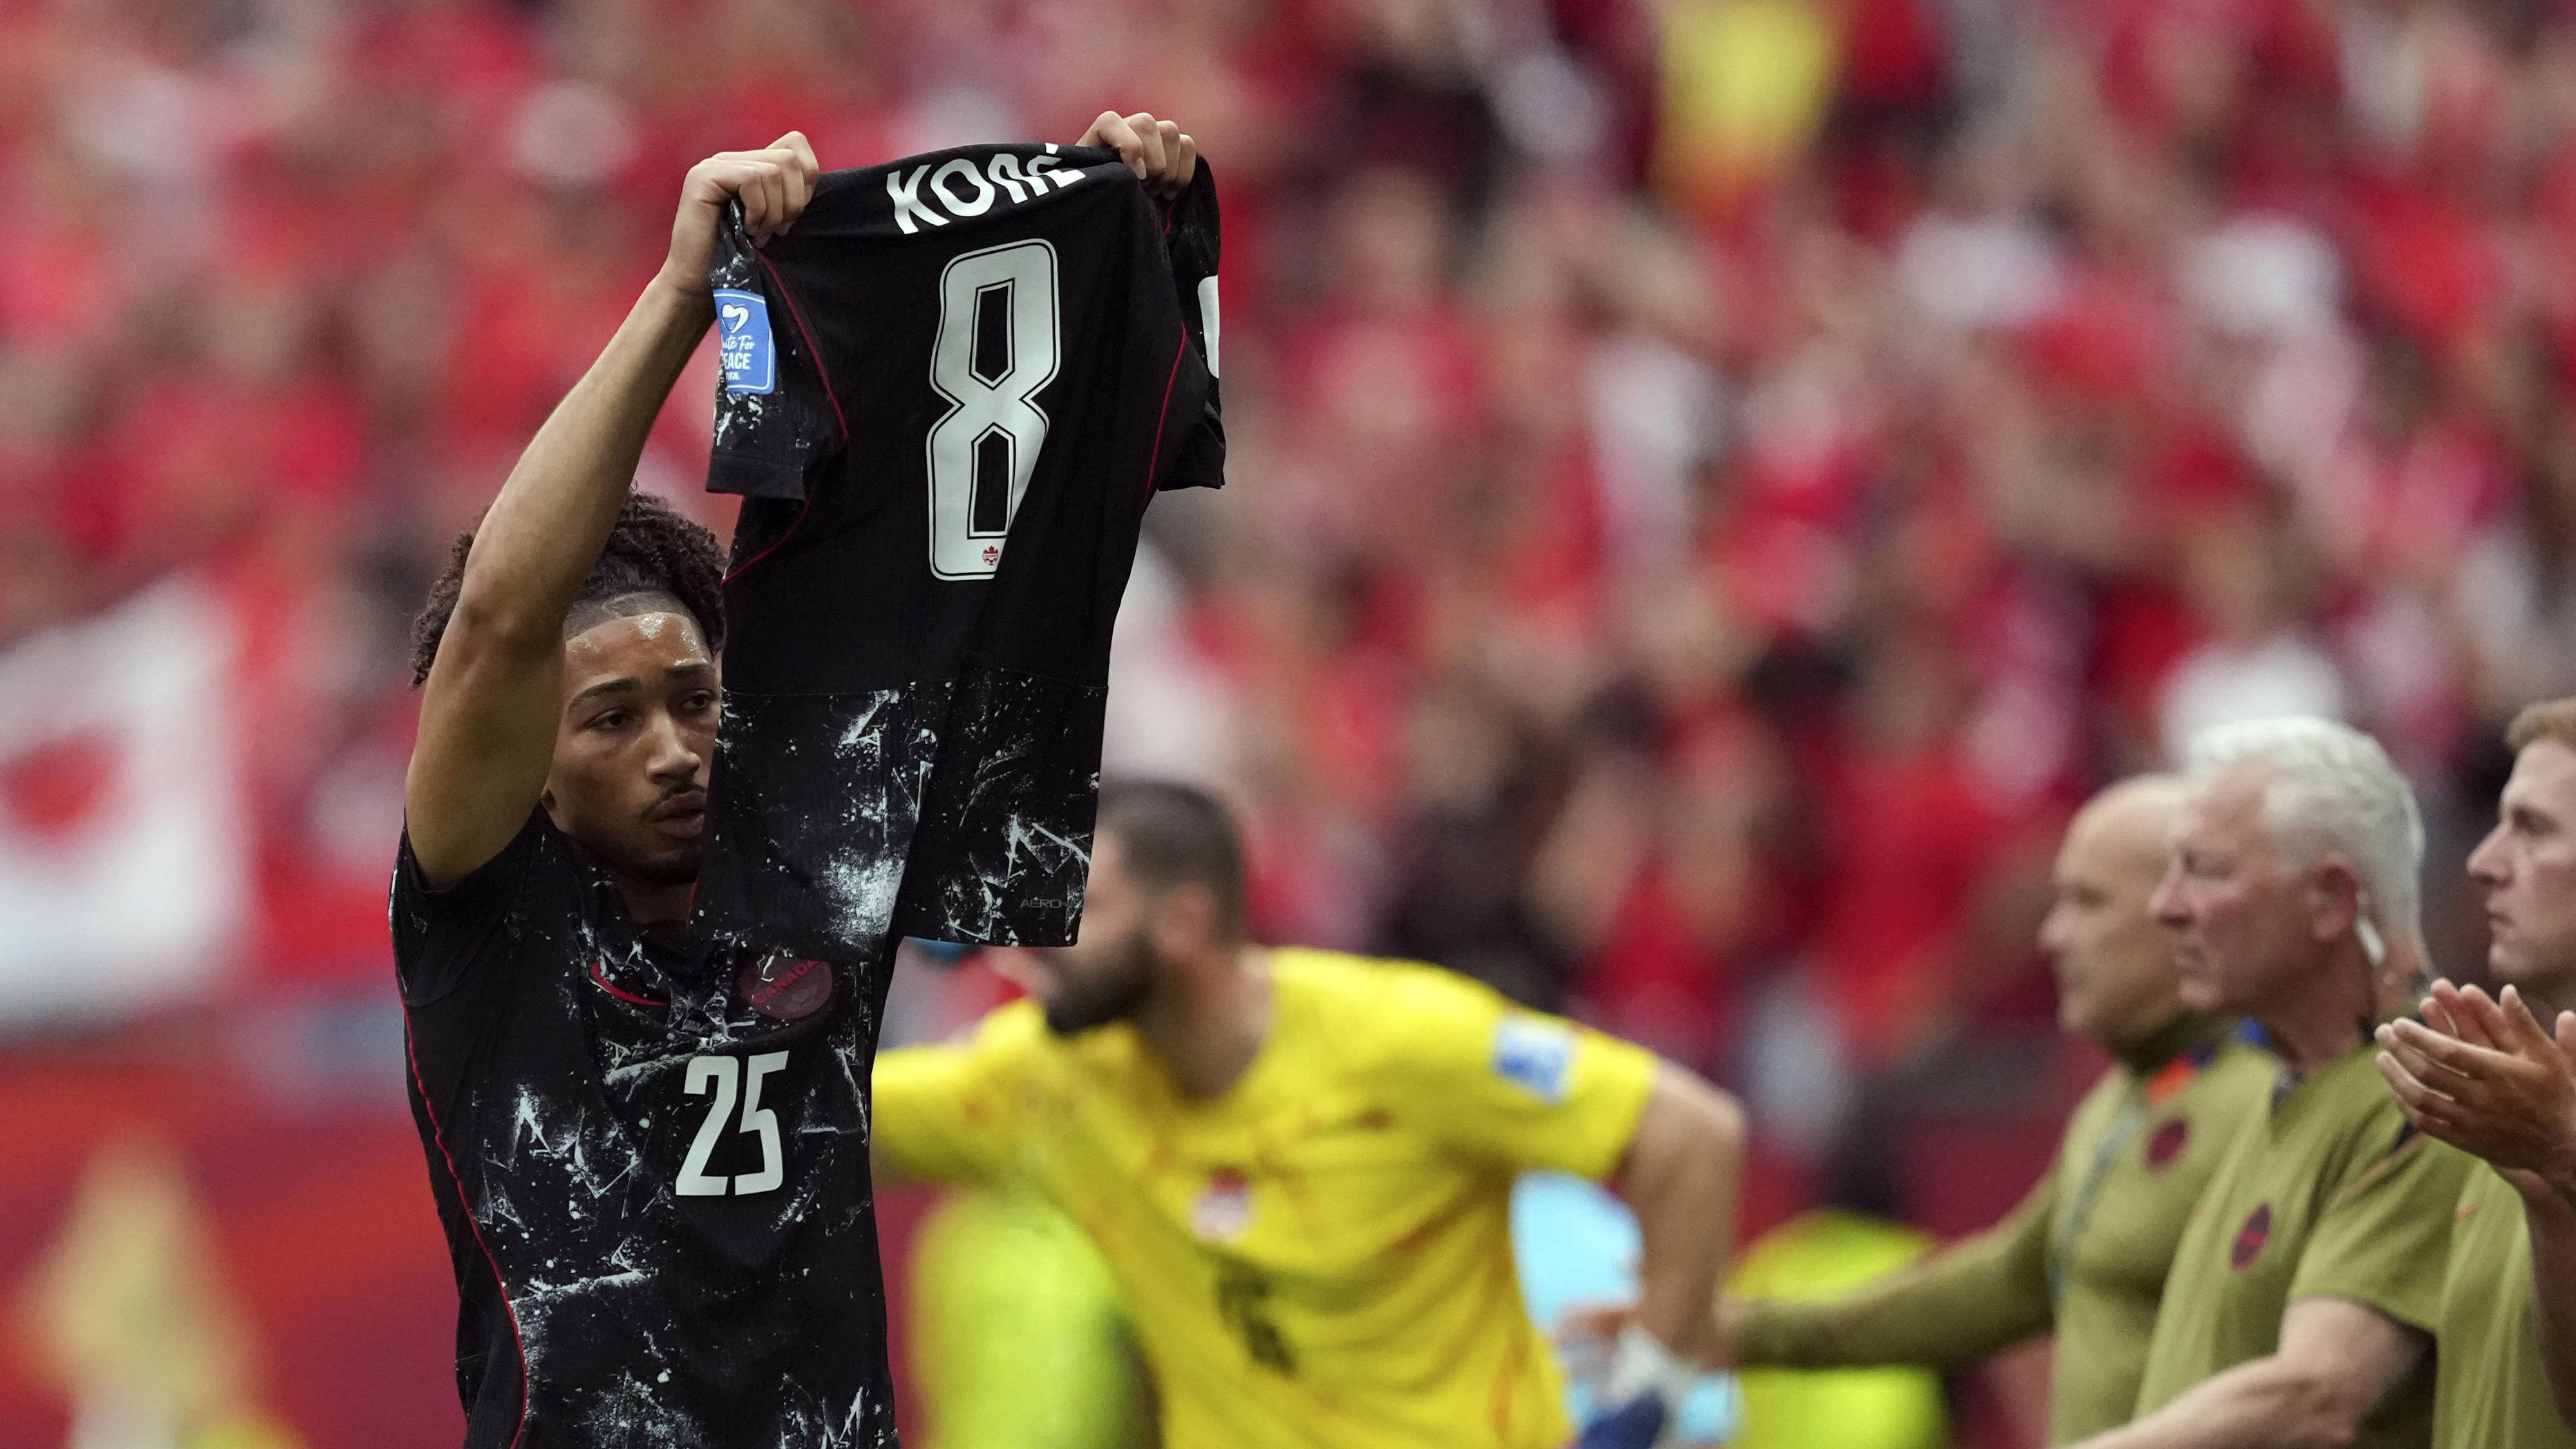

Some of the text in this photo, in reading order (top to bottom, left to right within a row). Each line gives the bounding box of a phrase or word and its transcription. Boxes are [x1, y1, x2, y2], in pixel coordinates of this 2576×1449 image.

[738, 334, 755, 352] For
[721, 352, 752, 370] EACE
[726, 372, 740, 381] IFA
[926, 238, 1061, 581] 8
[676, 1050, 790, 1196] 25
